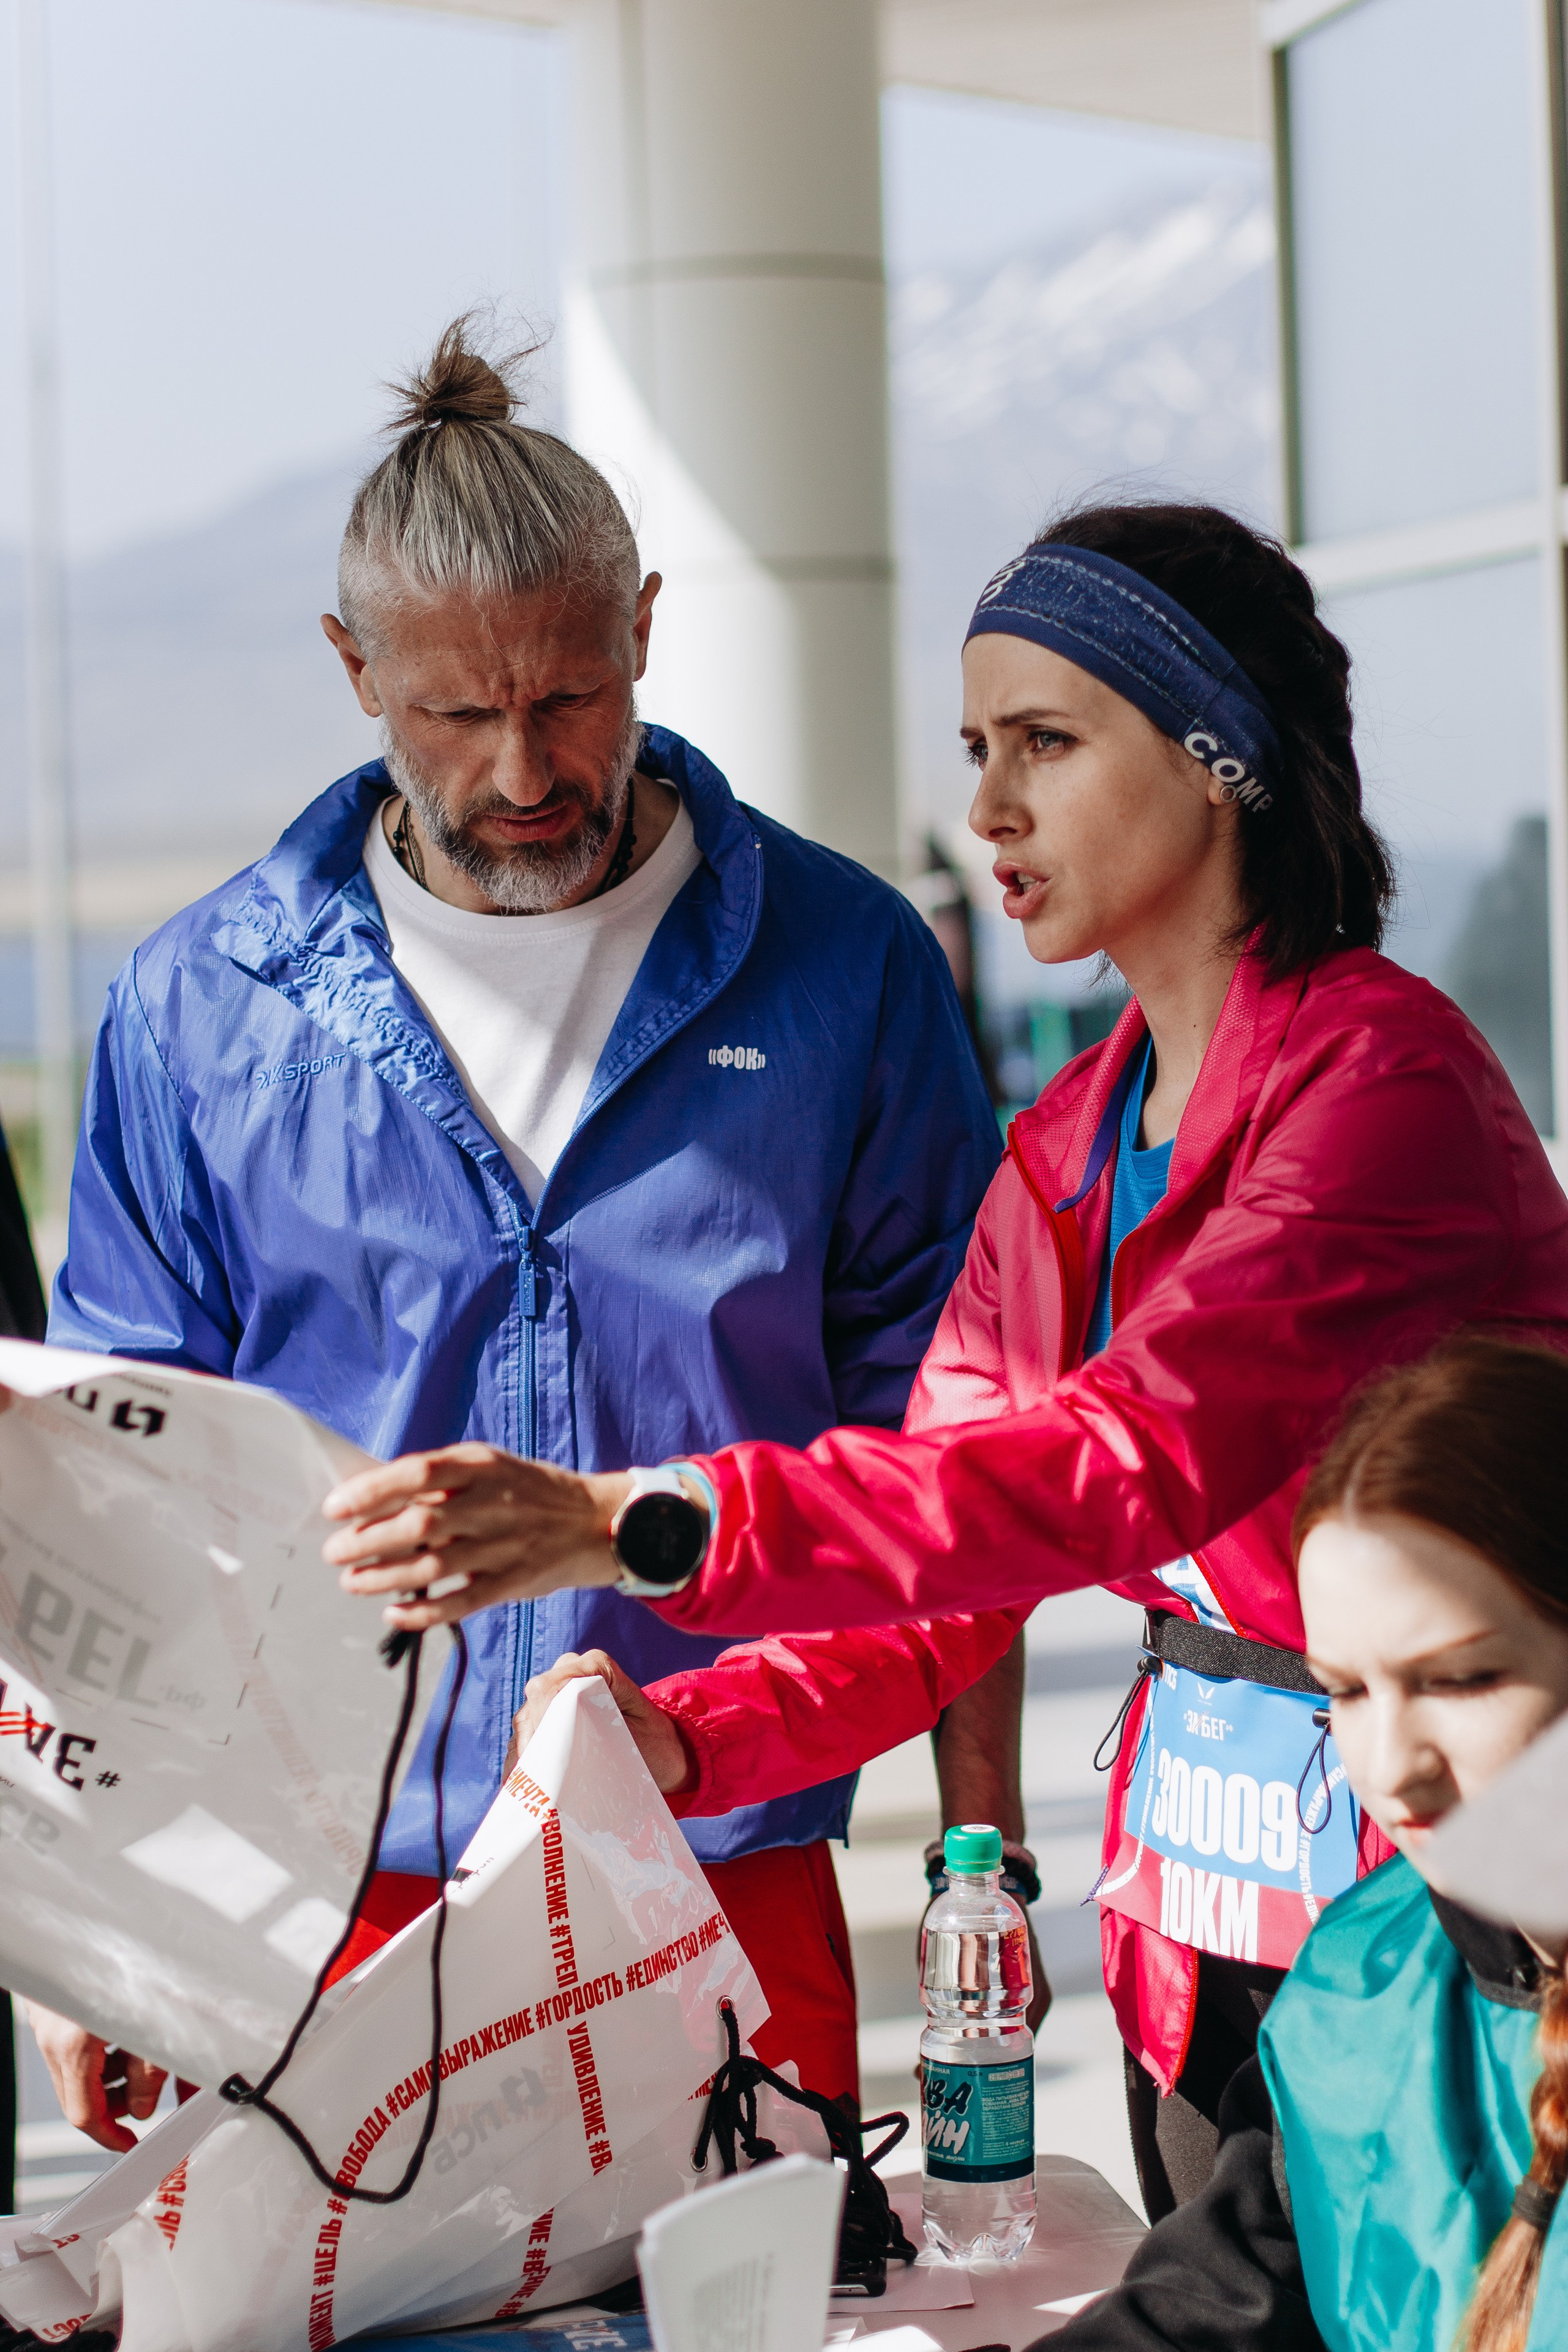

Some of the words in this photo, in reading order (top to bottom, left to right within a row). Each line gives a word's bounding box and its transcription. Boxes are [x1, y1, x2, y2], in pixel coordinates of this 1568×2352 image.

[1184, 732, 1273, 813] COMP
[1152, 1747, 1298, 1872] 30009
[540, 1808, 569, 1924] #ВОЛНЕНИЕ
[567, 2021, 606, 2140] УДИВЛЕНИЕ
[313, 2218, 342, 2286] #ЦЕЛЬ
[535, 1972, 624, 2030] #ГОРДОСТЬ
[625, 1931, 699, 1992] #ЕДИНСТВО
